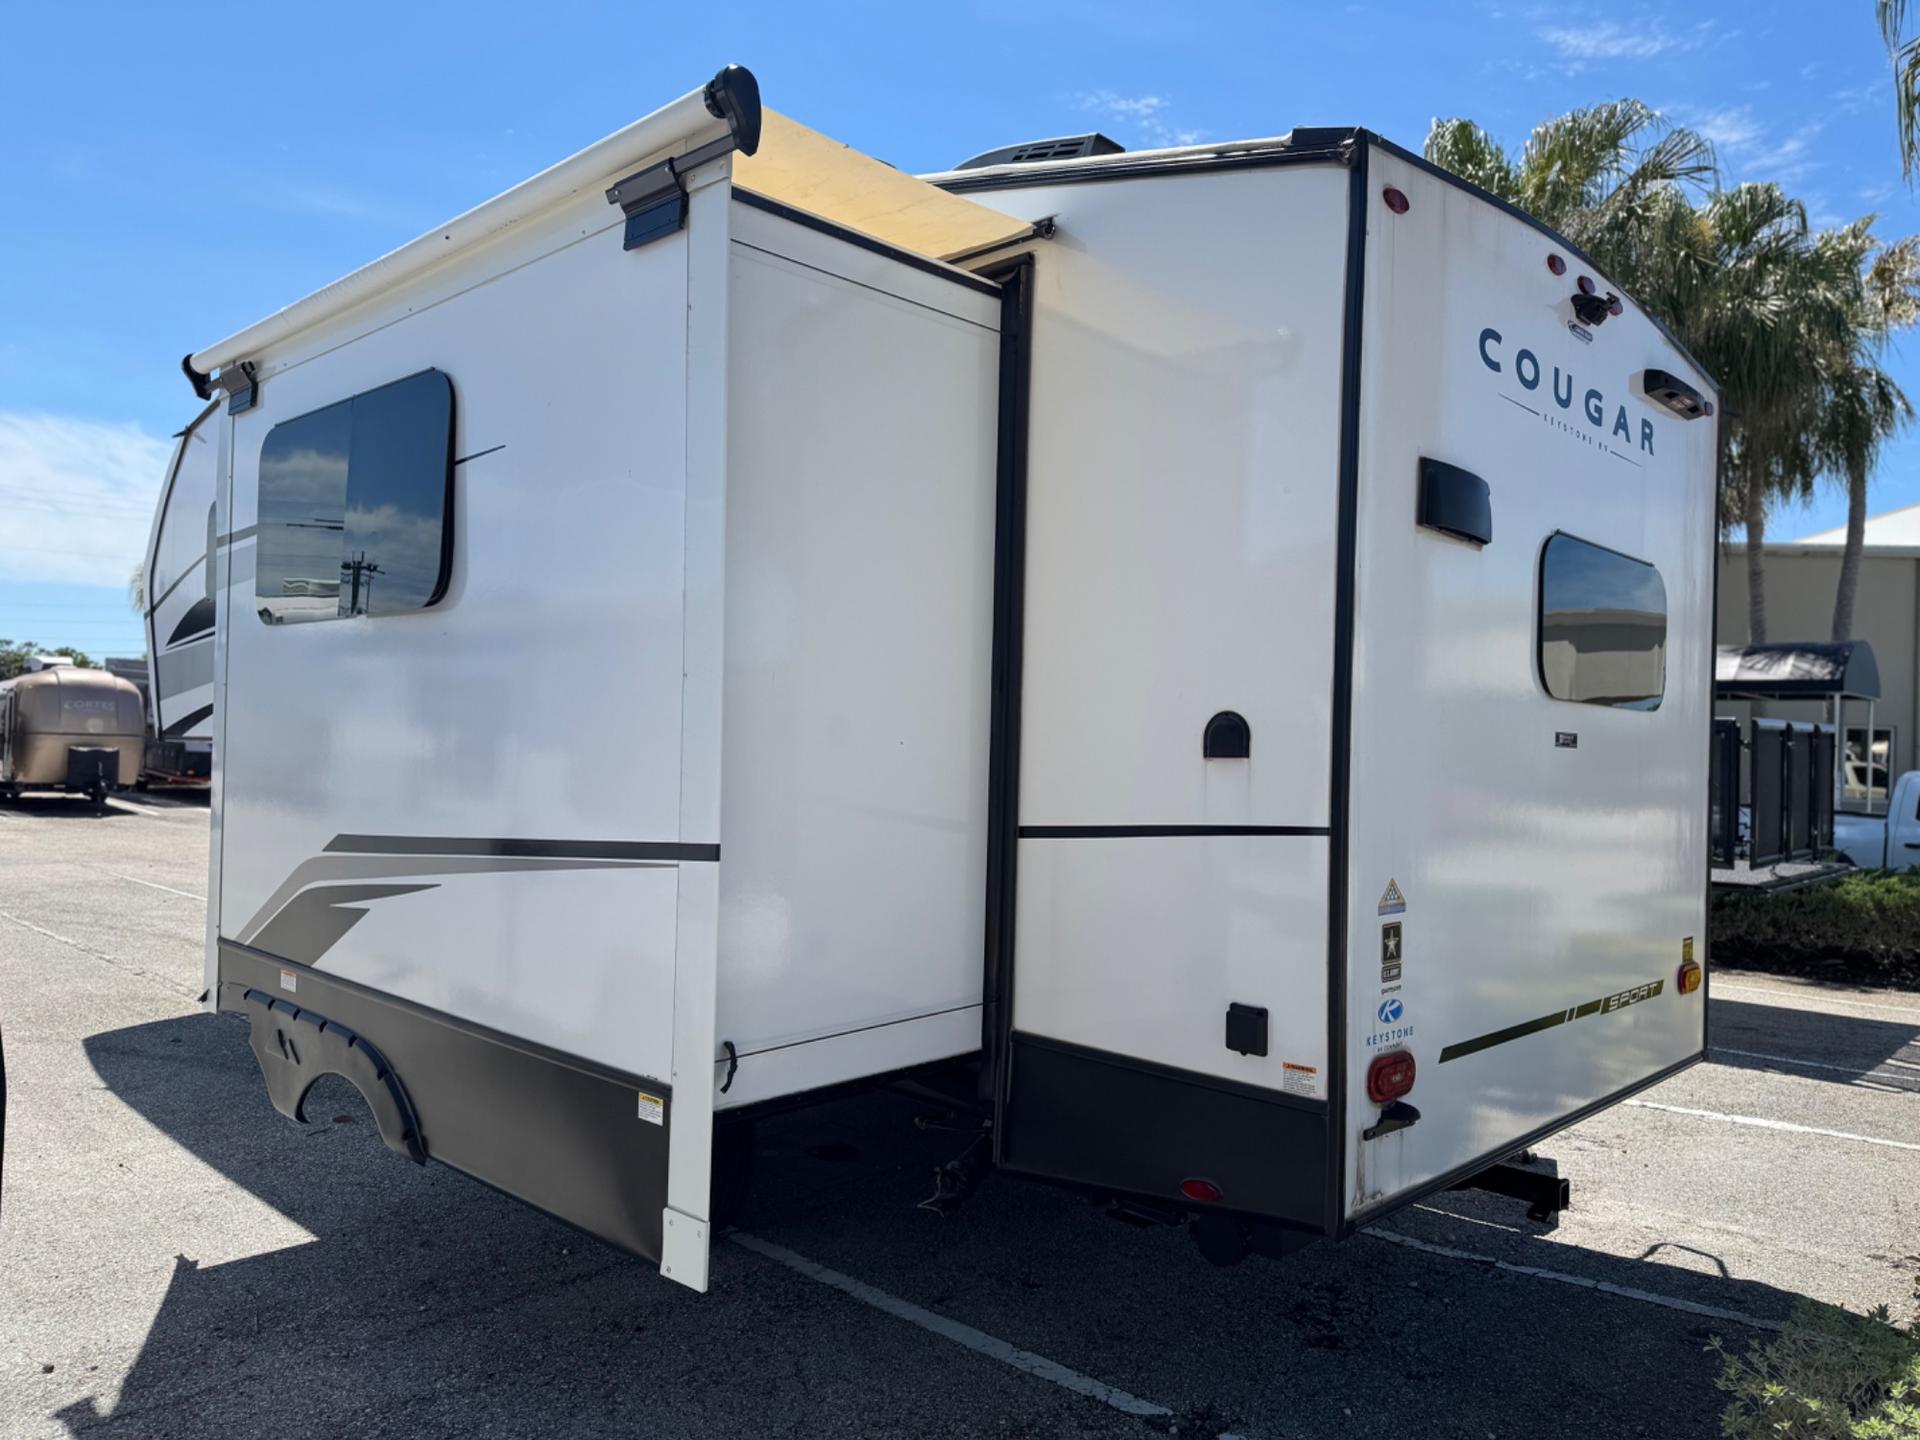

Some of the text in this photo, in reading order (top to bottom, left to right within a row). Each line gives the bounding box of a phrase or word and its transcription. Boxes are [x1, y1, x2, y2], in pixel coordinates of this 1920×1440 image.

[1479, 327, 1655, 457] COUGAR
[1543, 413, 1592, 445] KEYSTONE
[1608, 983, 1658, 1011] SPORT
[1366, 1025, 1414, 1046] KEYSTONE
